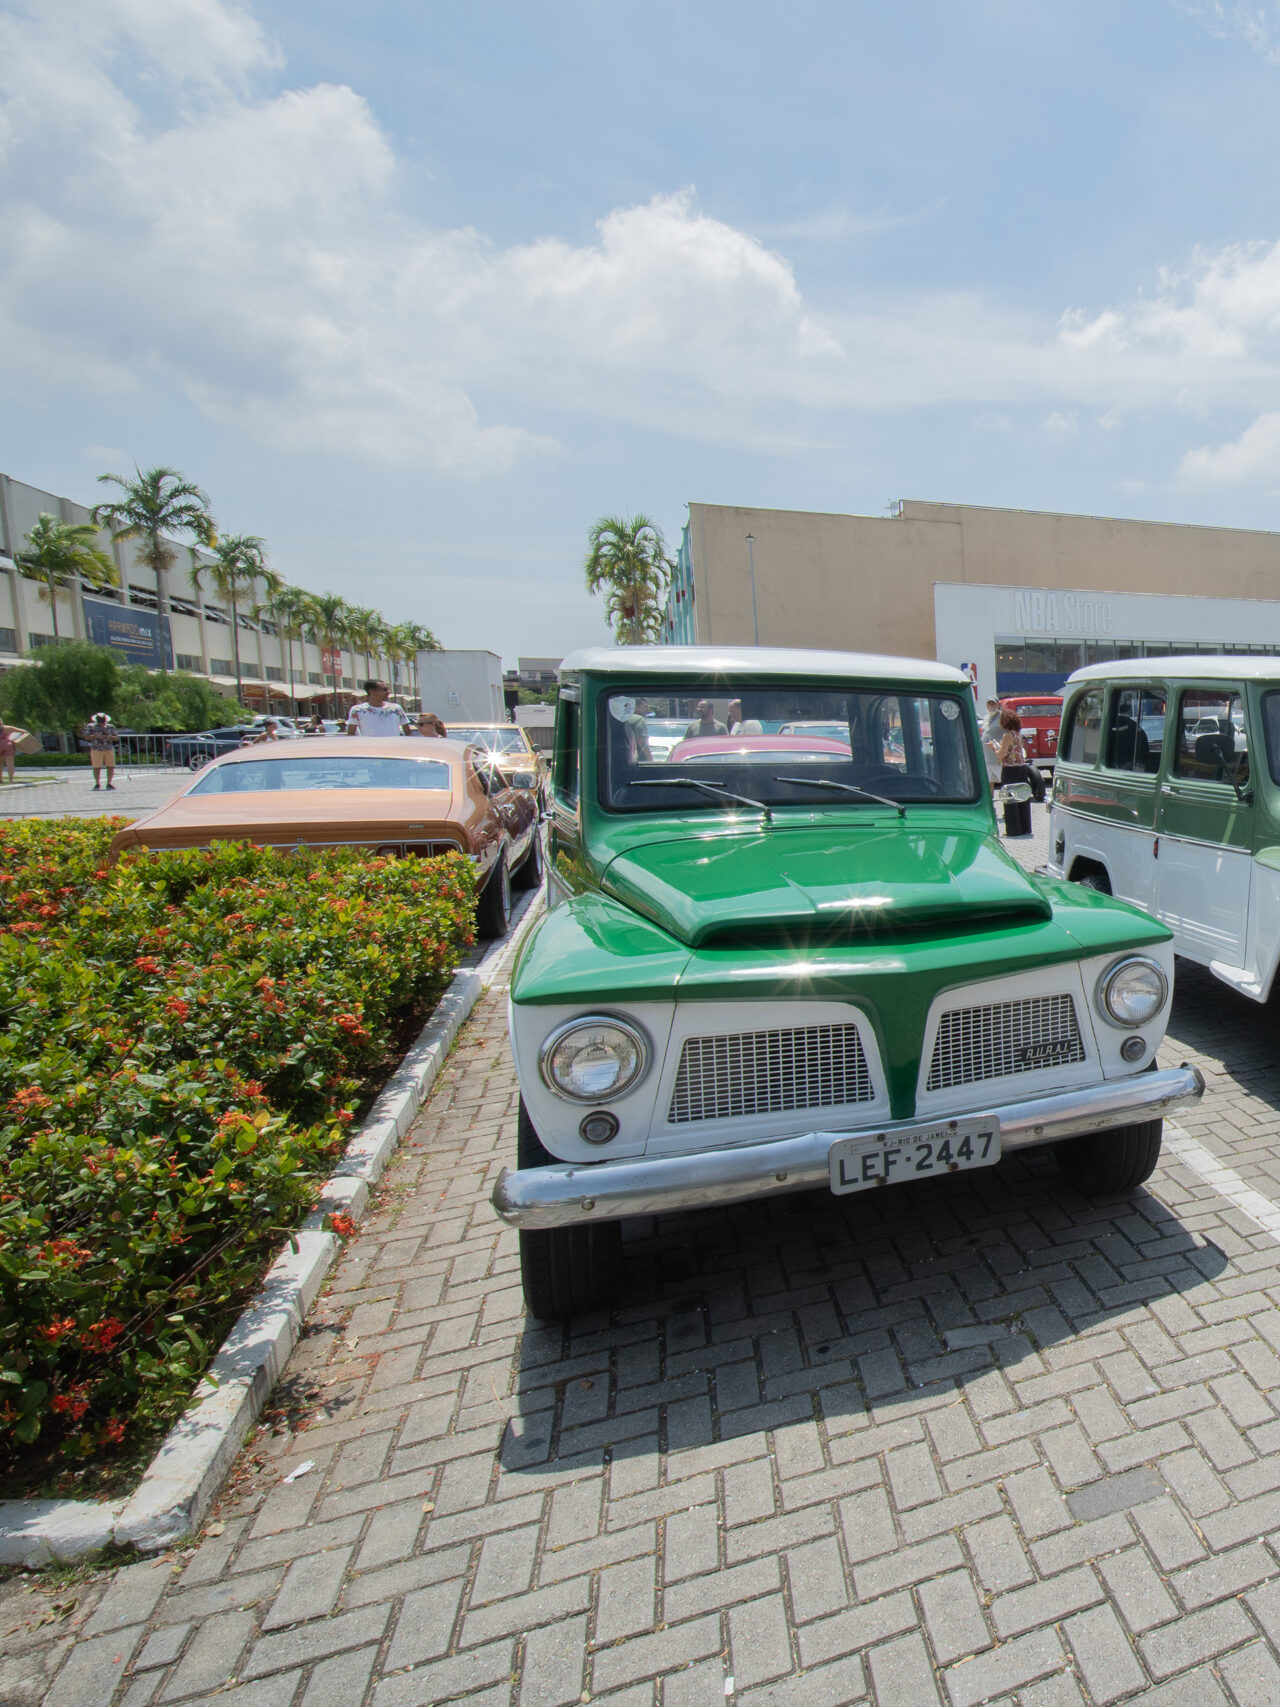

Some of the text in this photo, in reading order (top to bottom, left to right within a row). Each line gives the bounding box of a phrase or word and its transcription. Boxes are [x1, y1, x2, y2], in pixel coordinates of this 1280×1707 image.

[1014, 591, 1112, 633] NBA Store
[1026, 1042, 1070, 1060] RURAL
